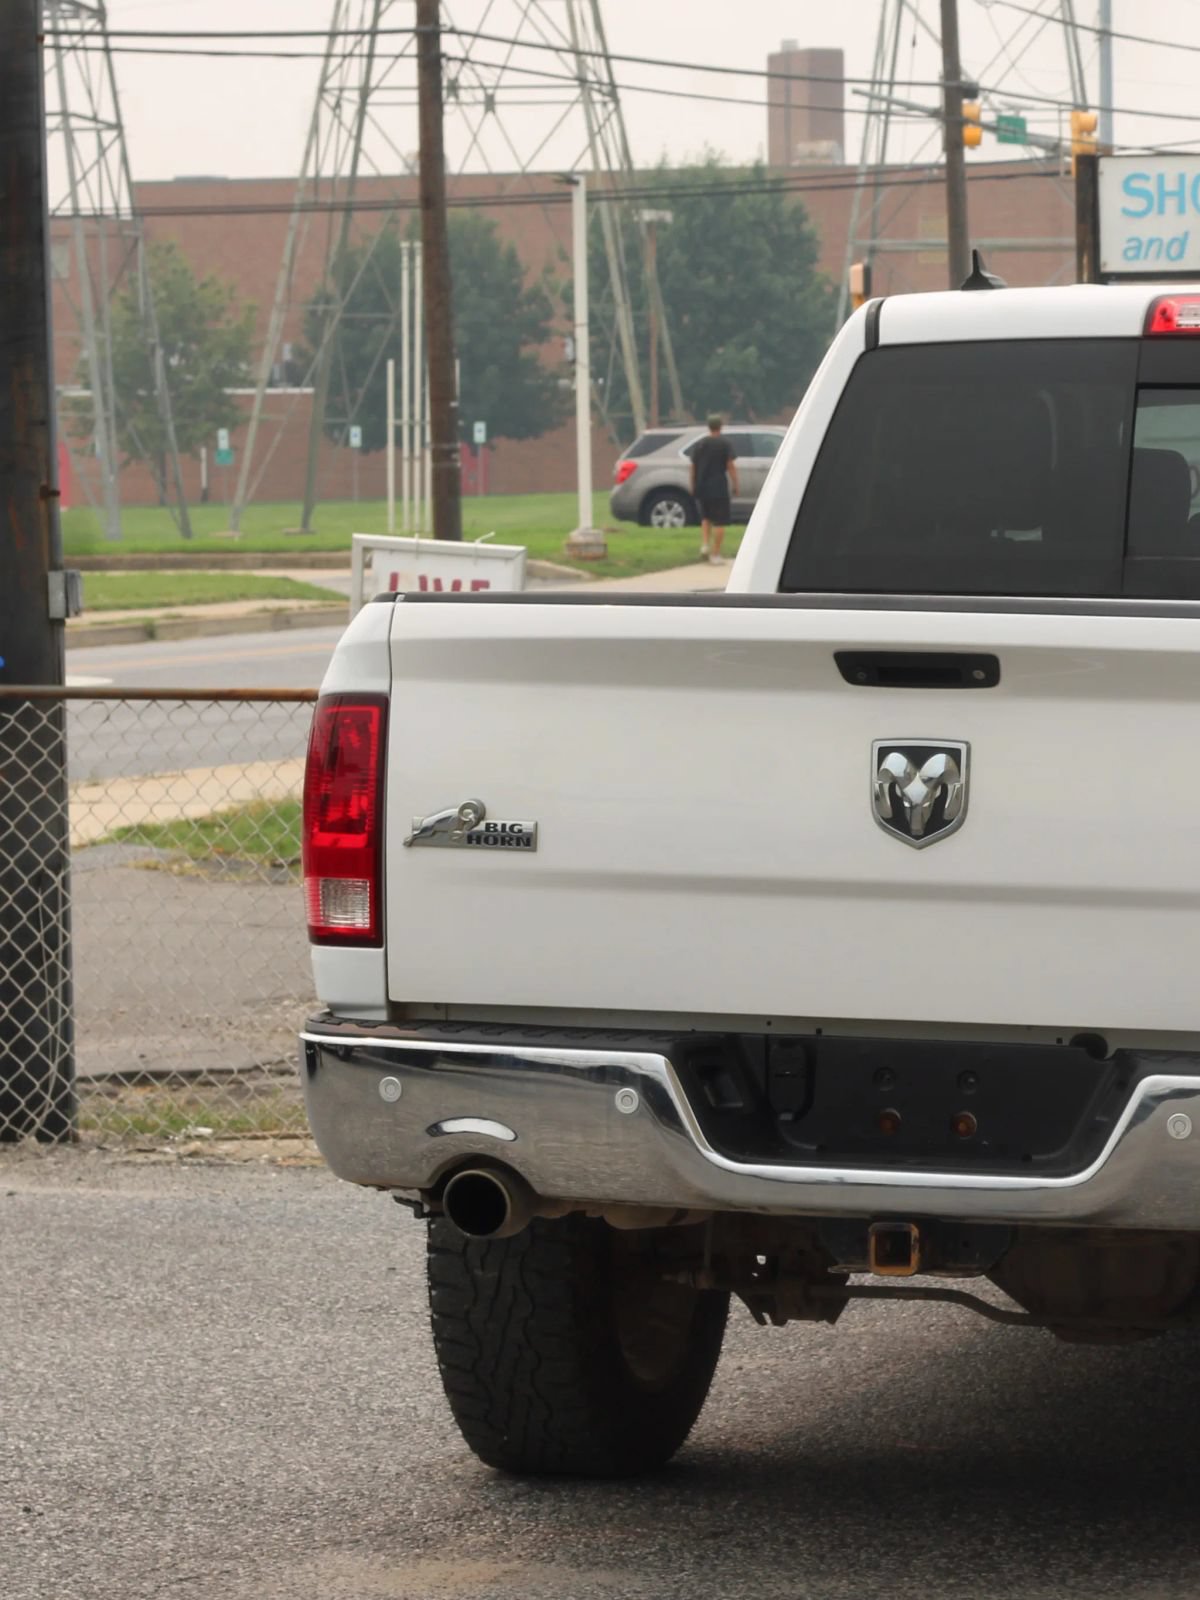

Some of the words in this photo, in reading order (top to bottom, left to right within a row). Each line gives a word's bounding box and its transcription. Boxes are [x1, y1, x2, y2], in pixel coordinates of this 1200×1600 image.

[1122, 230, 1189, 262] and
[484, 822, 523, 834] BIG
[466, 834, 531, 847] HORN
